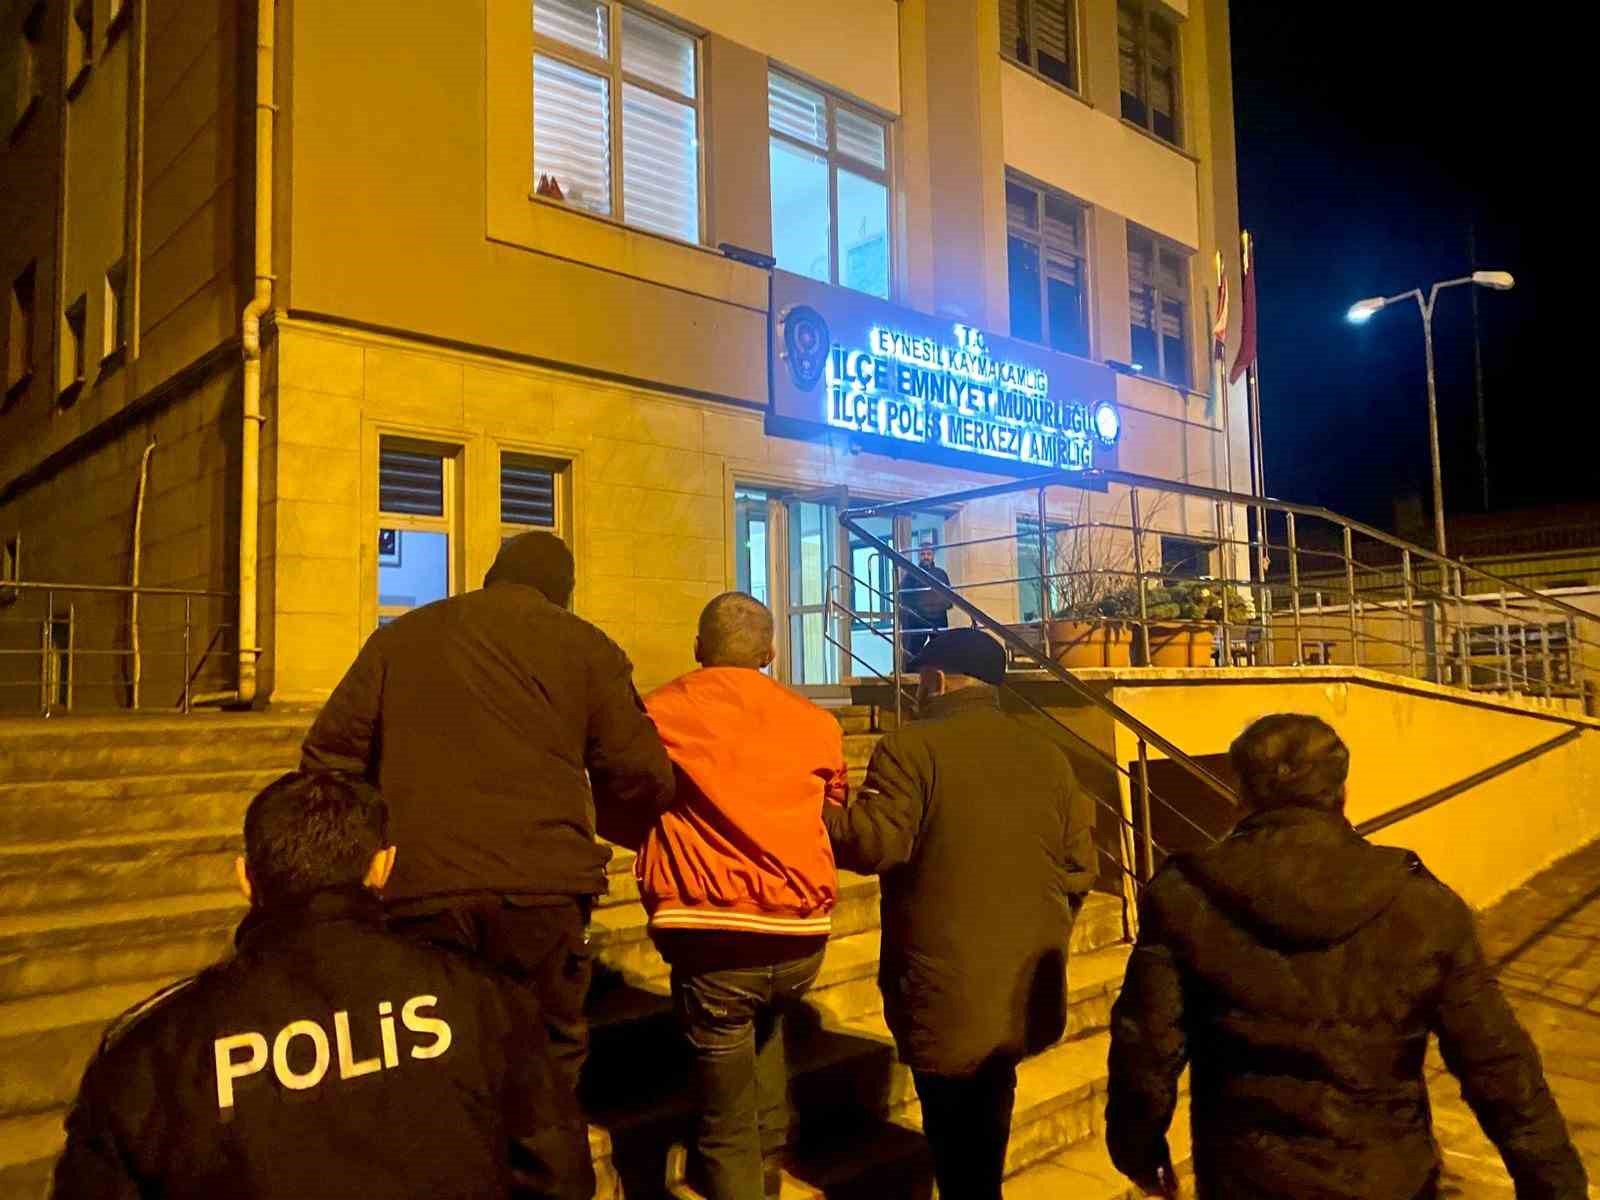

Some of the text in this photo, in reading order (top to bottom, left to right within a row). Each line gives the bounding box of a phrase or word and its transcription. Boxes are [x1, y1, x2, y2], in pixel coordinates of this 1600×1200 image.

[831, 344, 890, 391] İLÇE
[897, 364, 993, 413] EMNİYET
[879, 330, 944, 366] EYNESİL
[832, 384, 879, 431] İLÇE
[947, 415, 1022, 456] MERKEZİ
